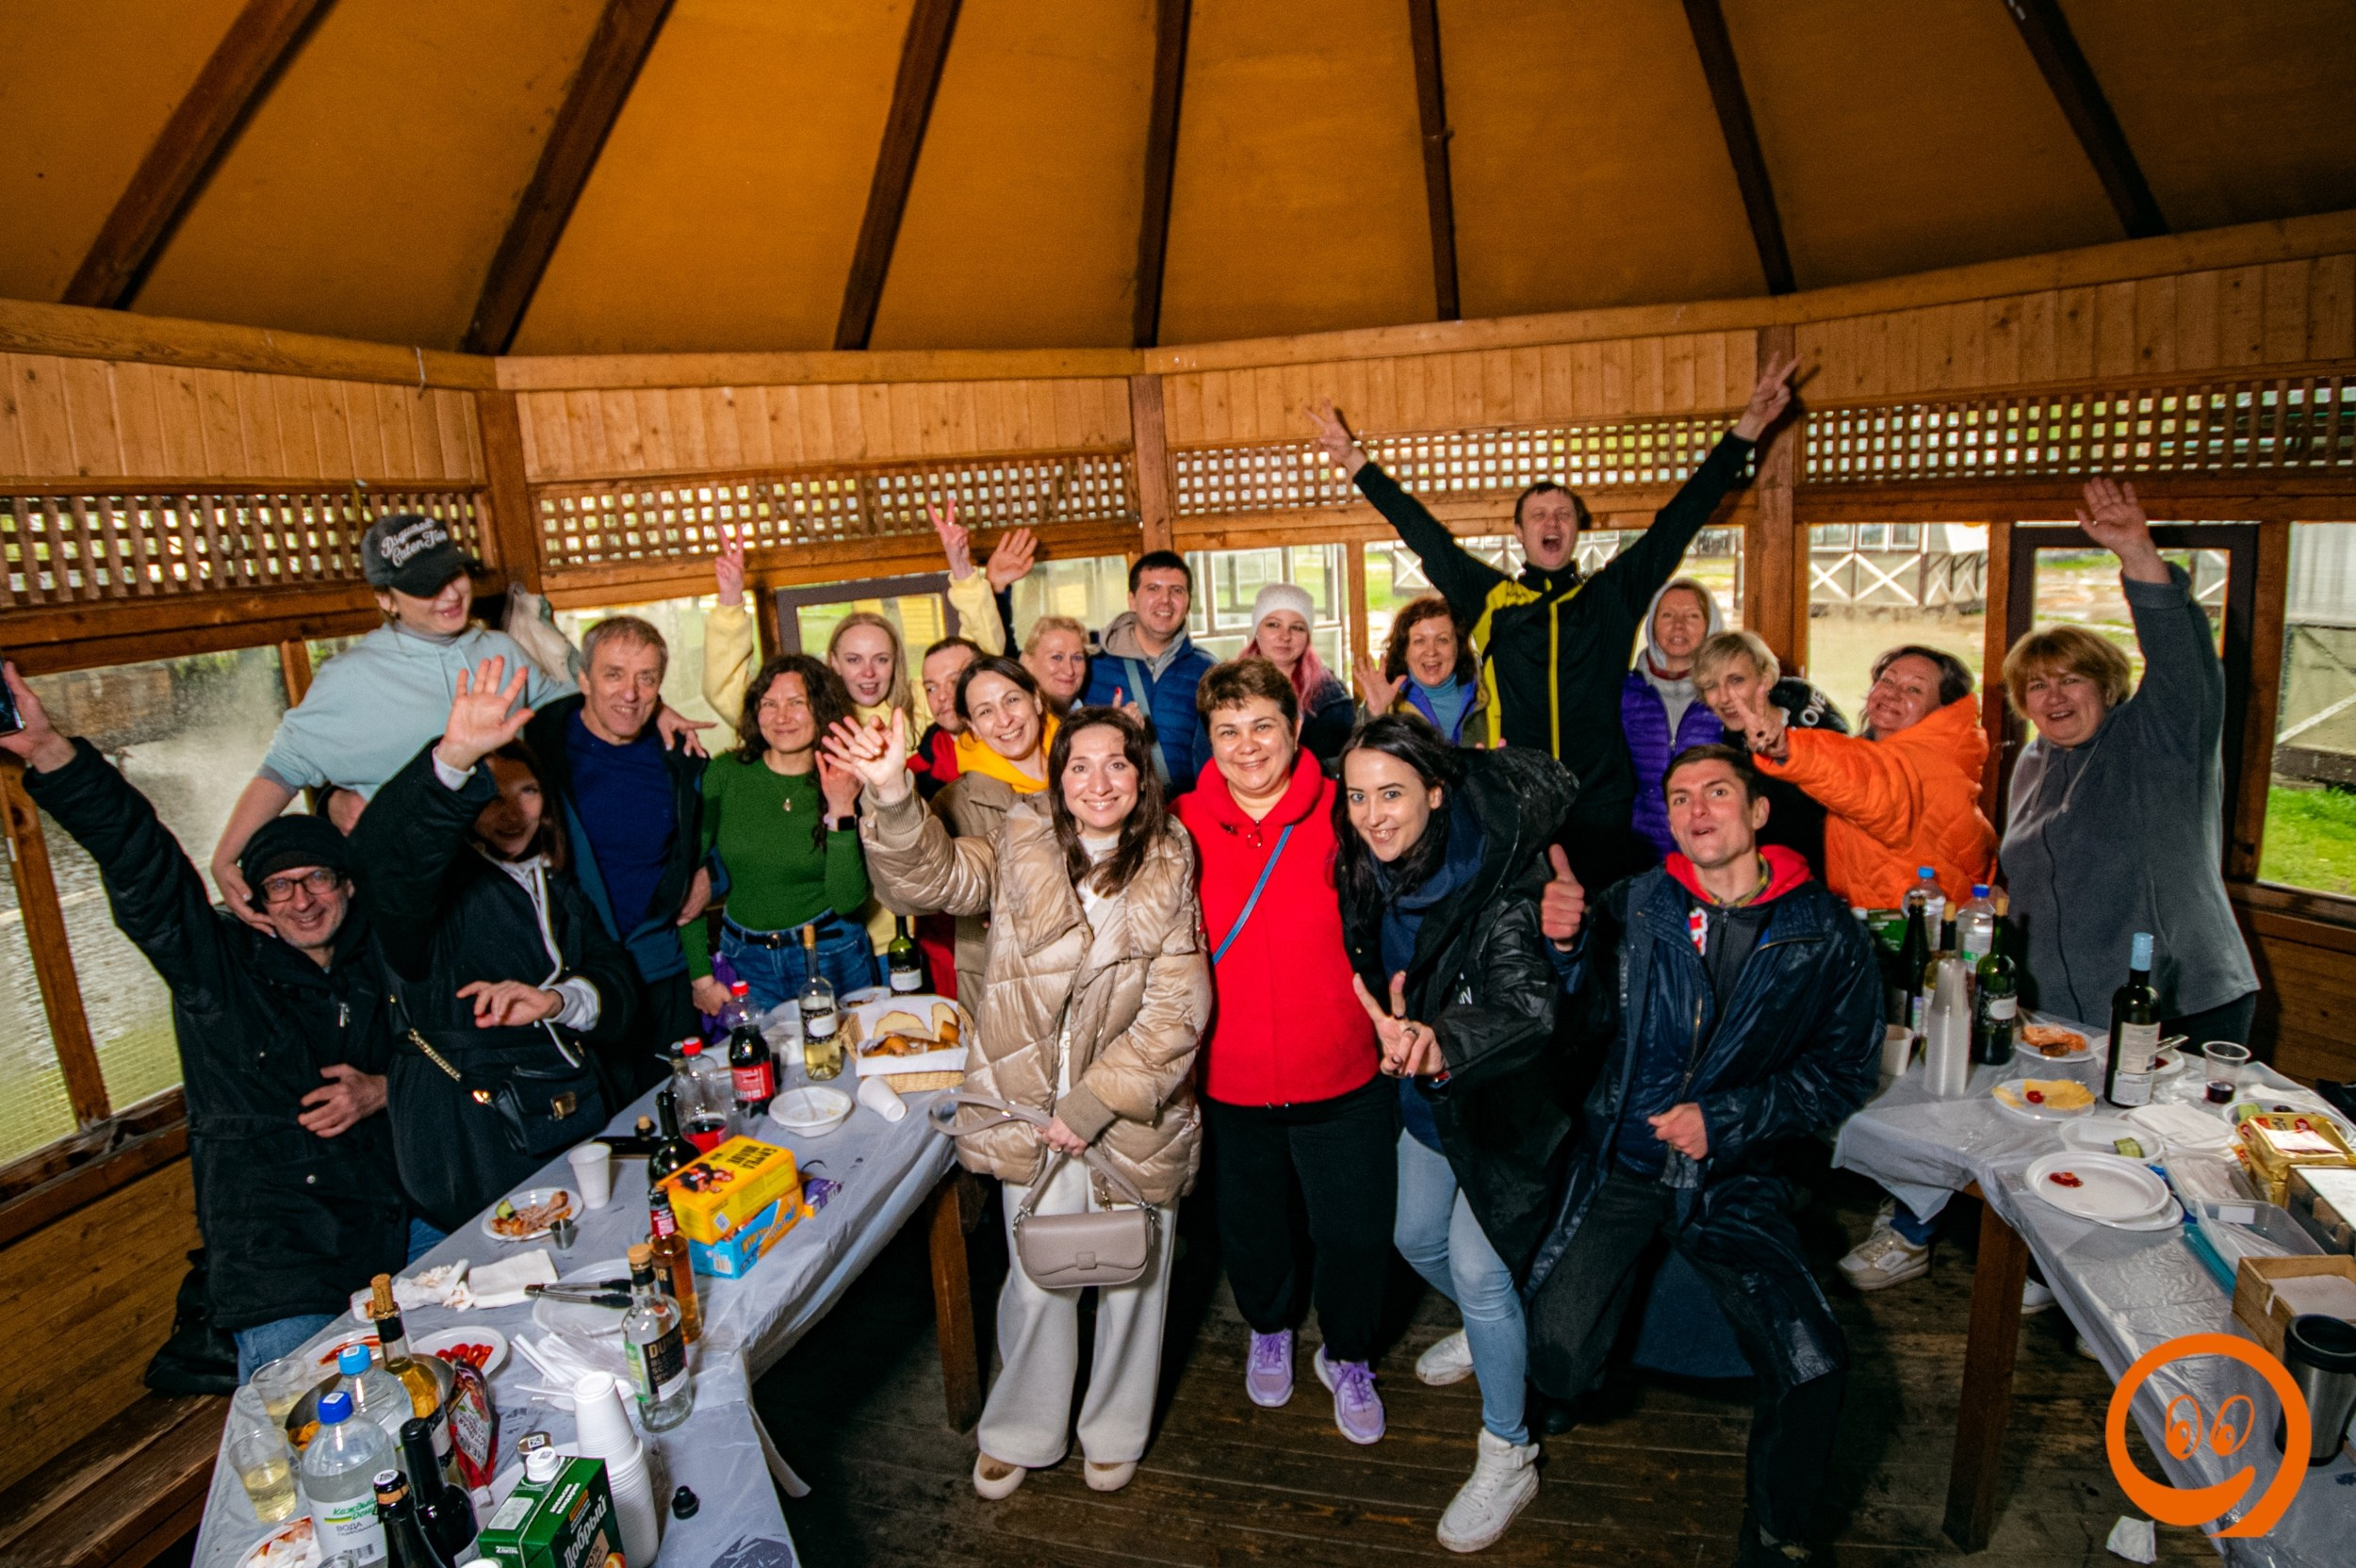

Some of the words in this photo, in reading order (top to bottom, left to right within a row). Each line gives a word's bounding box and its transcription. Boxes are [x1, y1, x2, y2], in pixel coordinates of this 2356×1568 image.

[1799, 688, 1826, 727] OVE
[335, 1521, 363, 1532] ВОДА
[564, 1494, 607, 1568] Добрый
